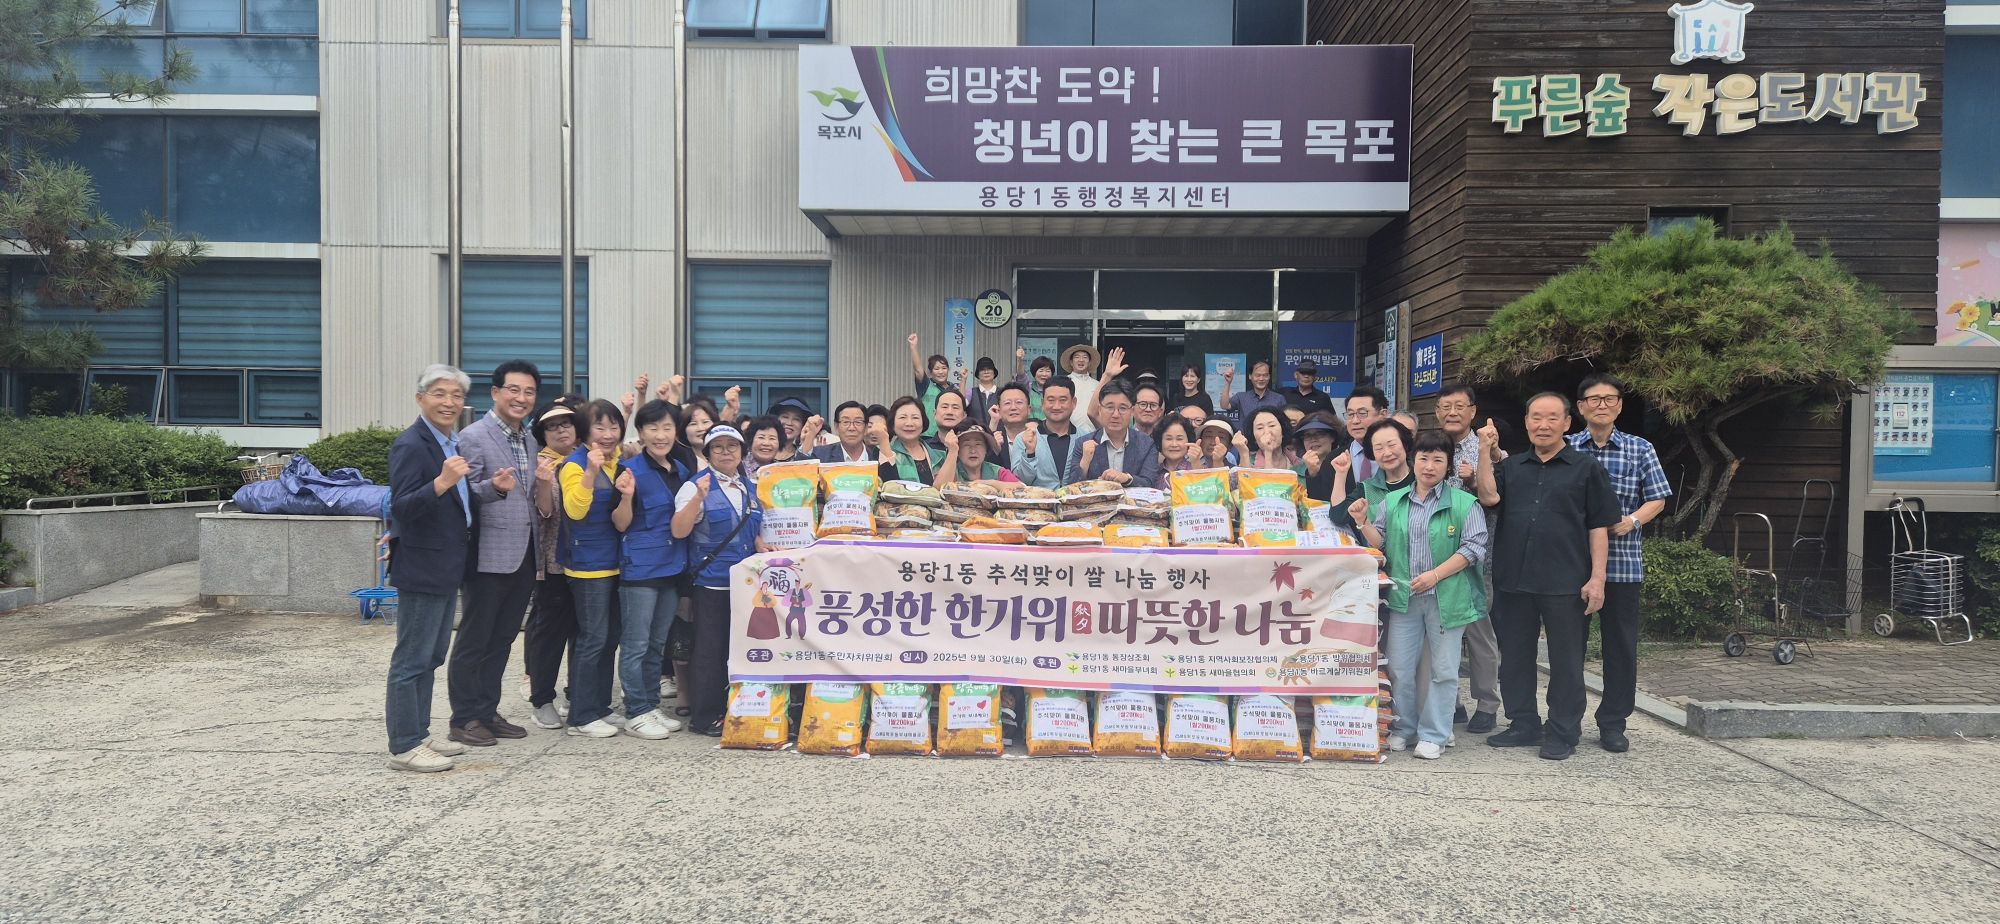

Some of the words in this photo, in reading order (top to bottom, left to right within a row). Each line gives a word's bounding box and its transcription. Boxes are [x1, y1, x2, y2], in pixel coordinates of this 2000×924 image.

[925, 66, 1041, 104] 희망찬
[1057, 66, 1136, 104] 도약
[1152, 67, 1161, 103] !
[1493, 74, 1631, 137] 푸른숲
[1653, 73, 1926, 136] 작은도서관
[817, 125, 862, 141] 목포시
[974, 119, 1108, 163] 청년이
[1130, 119, 1220, 163] 찾는
[1240, 120, 1283, 162] 큰
[1305, 120, 1396, 163] 목포
[979, 186, 1232, 209] 용당1동행정복지센터
[985, 305, 1003, 316] 20
[898, 560, 977, 585] 용당1동
[987, 563, 1074, 588] 추석맞이
[1084, 565, 1106, 589] 쌀
[1115, 567, 1157, 590] 나눔
[1167, 568, 1211, 590] 행사
[767, 570, 791, 593] 福
[816, 590, 937, 638] 풍성한
[945, 592, 1067, 643] 한가위
[1099, 599, 1226, 645] 따뜻한
[1233, 600, 1316, 646] 나눔
[749, 651, 770, 660] 주관
[795, 650, 893, 662] 용당1동주민자치위원회
[902, 652, 924, 662] 일시
[933, 652, 967, 662] 2025년
[970, 654, 986, 663] 9월
[989, 655, 1027, 665] 30일(화)
[1082, 652, 1109, 662] 용당1동
[1178, 654, 1206, 664] 용당1동
[1208, 654, 1278, 664] 지역사회보장협의체
[1300, 653, 1329, 663] 용당1동
[1037, 657, 1057, 668] 후원
[1082, 664, 1109, 673] 용당1동
[1112, 665, 1158, 675] 새마을부녀회
[1179, 668, 1207, 677] 용당1동
[1209, 668, 1256, 677] 새마을협의회
[1279, 667, 1308, 677] 용당1동
